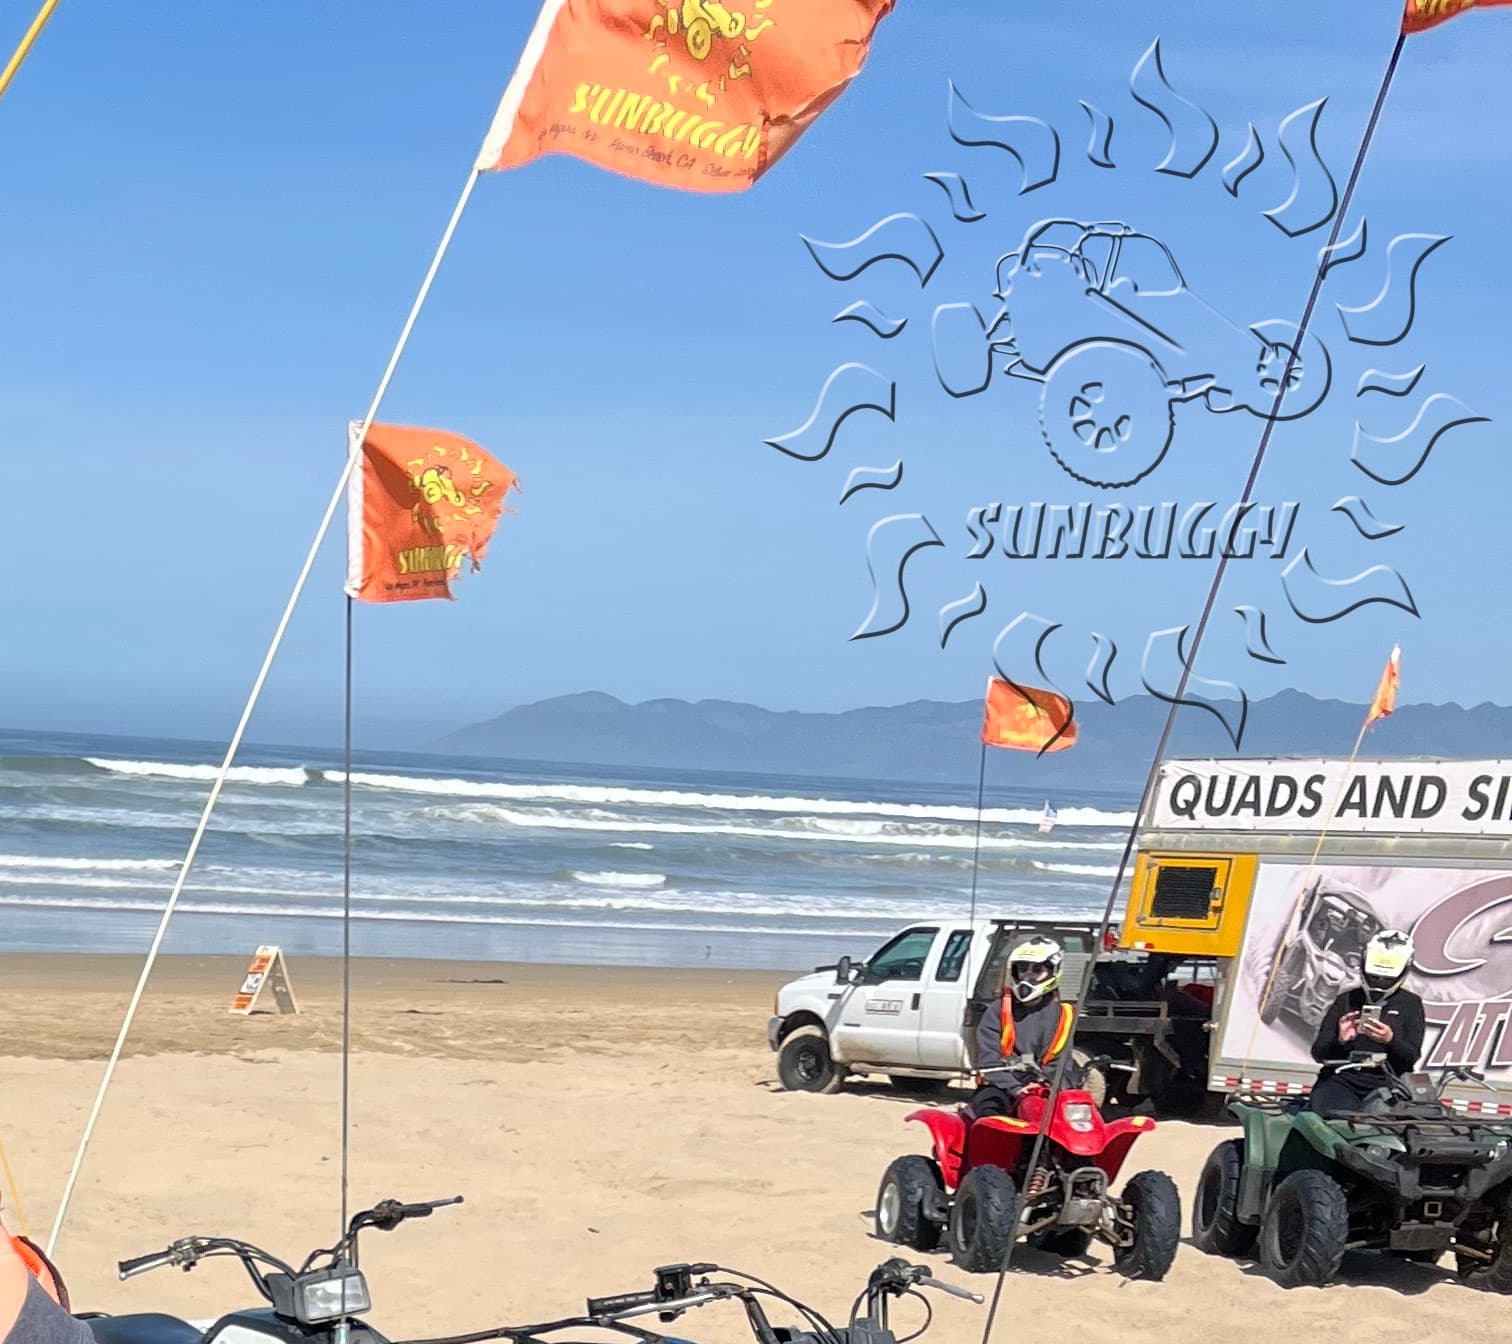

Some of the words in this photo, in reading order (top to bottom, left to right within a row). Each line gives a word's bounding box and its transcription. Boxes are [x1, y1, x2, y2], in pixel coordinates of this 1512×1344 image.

[1169, 774, 1327, 821] QUADS
[1334, 774, 1448, 819] AND
[1461, 774, 1512, 822] SI
